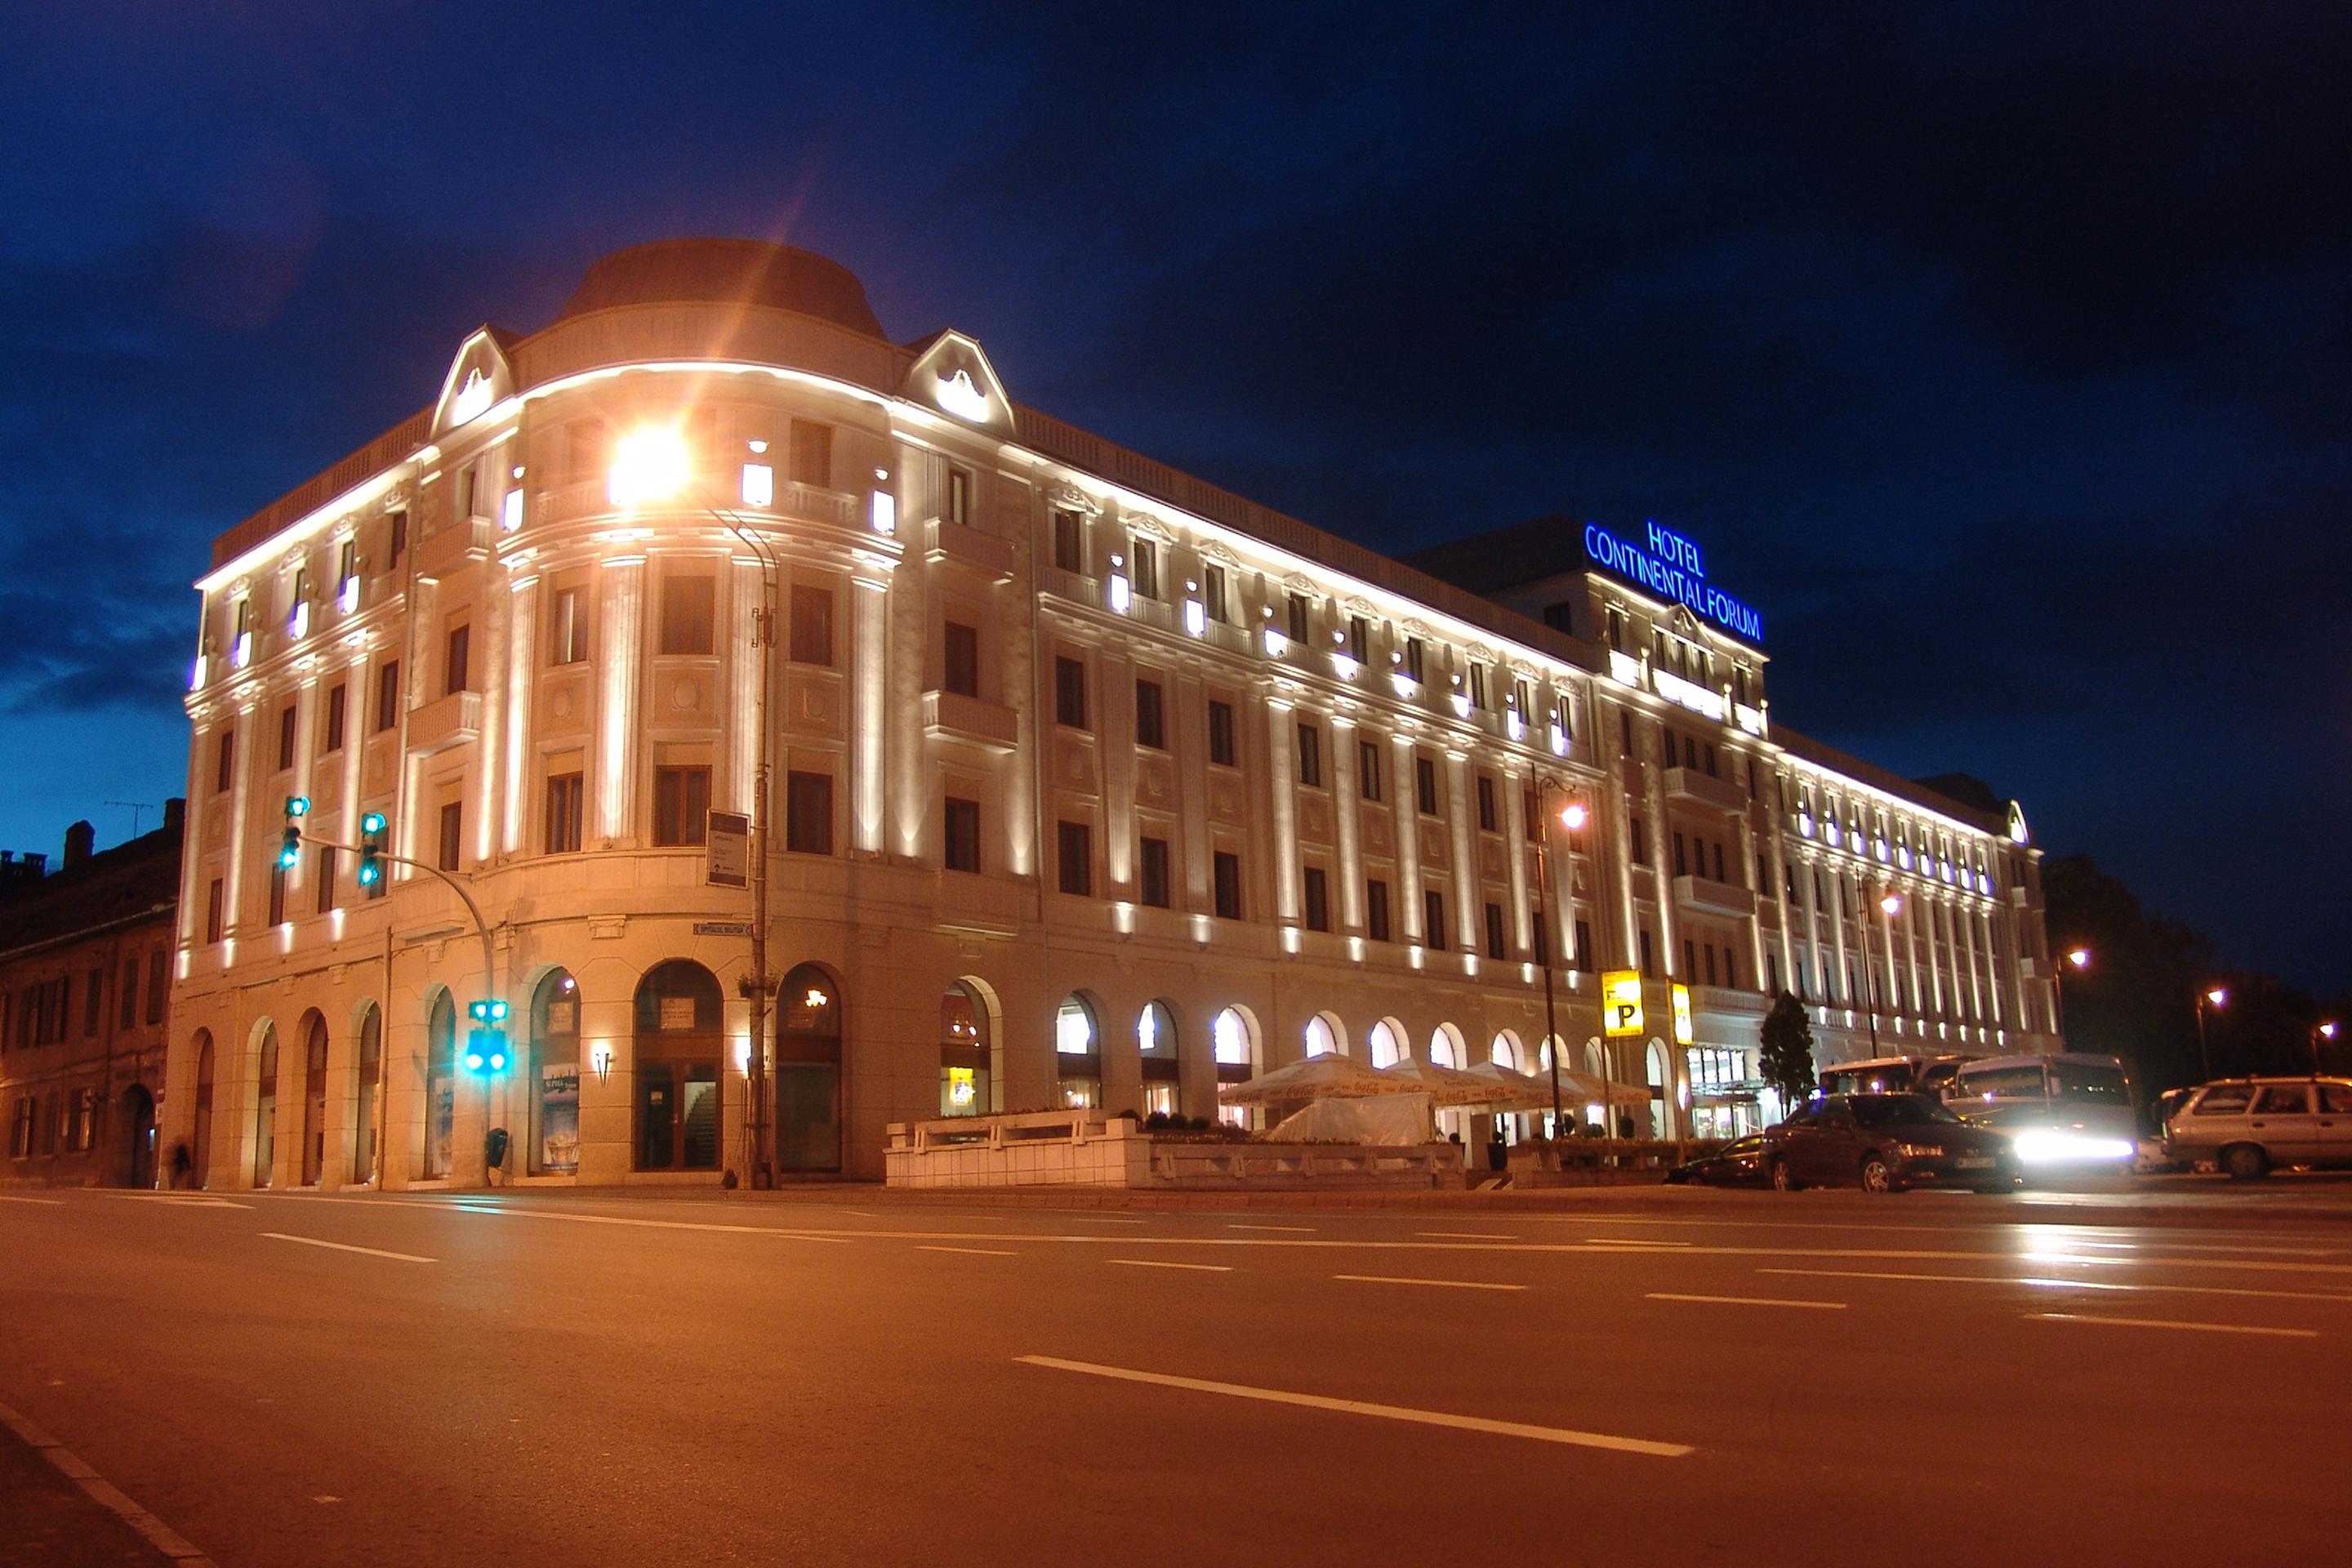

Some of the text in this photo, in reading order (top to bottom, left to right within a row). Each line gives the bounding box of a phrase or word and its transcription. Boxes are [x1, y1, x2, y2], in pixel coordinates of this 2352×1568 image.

[1647, 521, 1704, 578] HOTEL
[1585, 525, 1761, 641] CONTINENTAL FORUM
[1617, 1004, 1636, 1029] P
